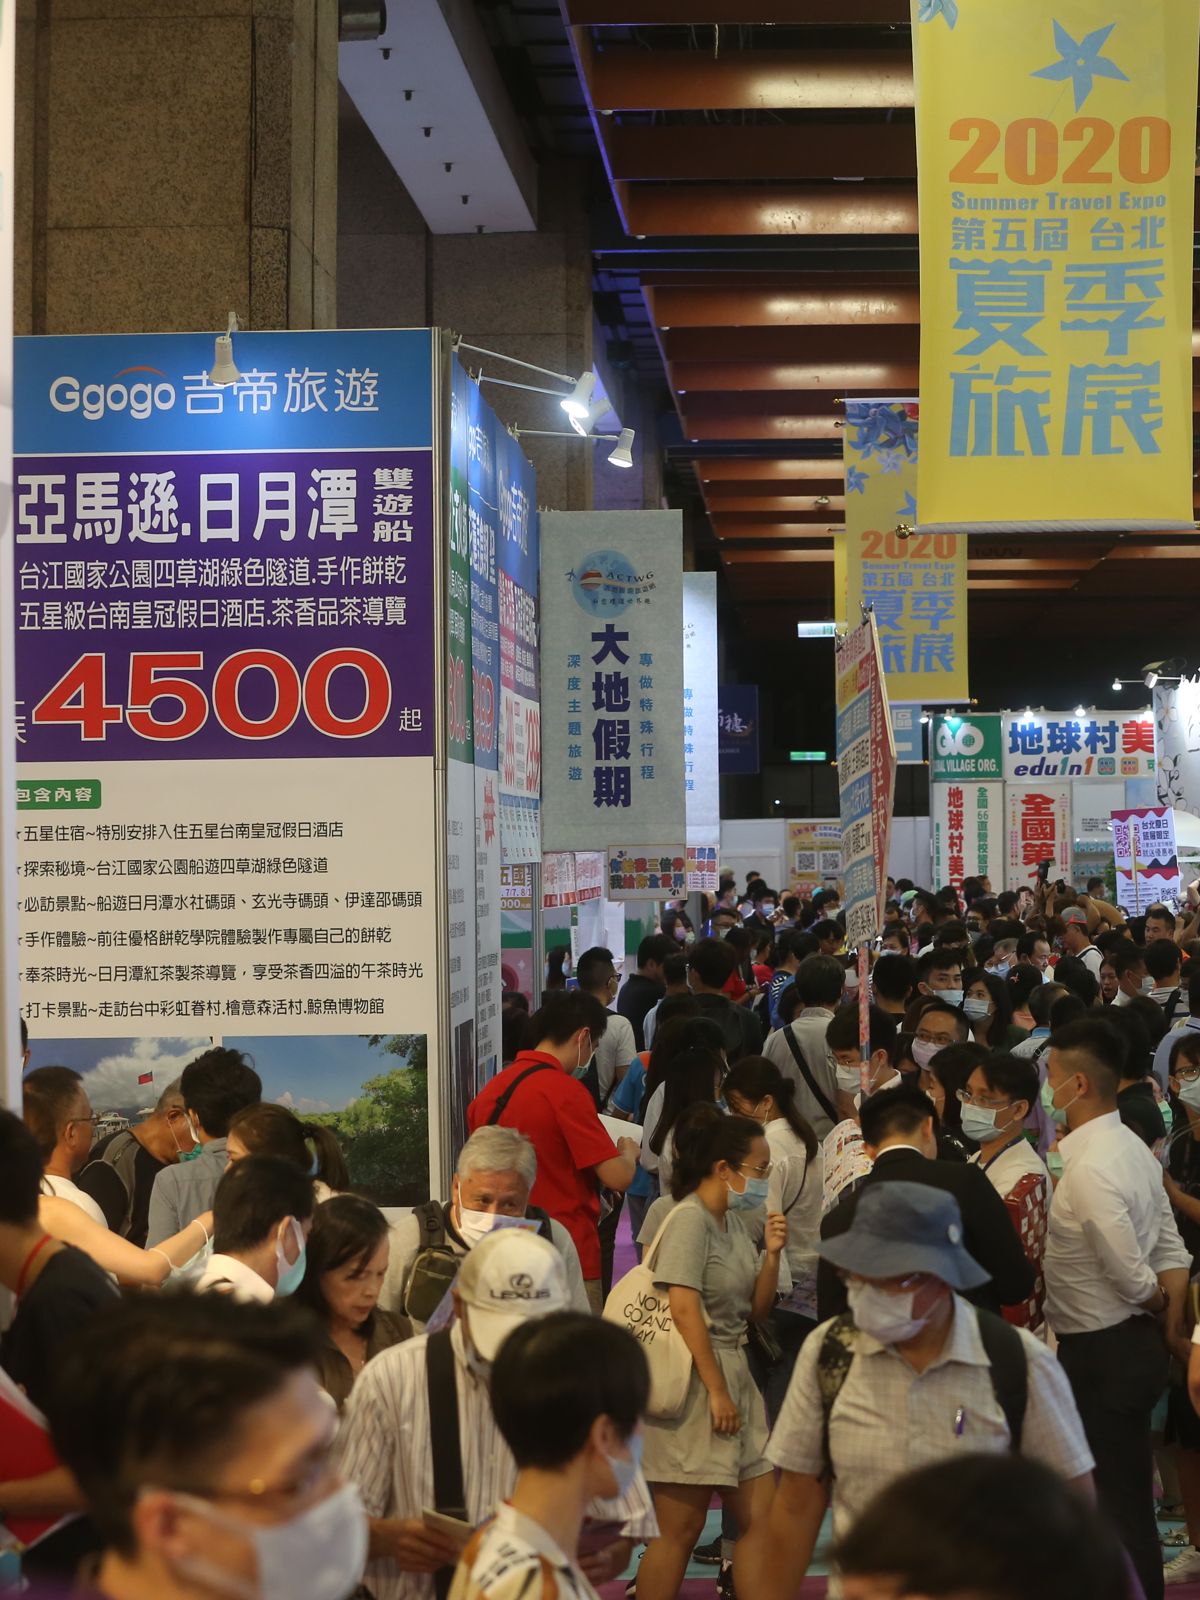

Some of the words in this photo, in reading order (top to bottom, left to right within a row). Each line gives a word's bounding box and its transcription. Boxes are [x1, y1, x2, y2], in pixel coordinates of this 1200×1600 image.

[949, 117, 1172, 185] 2020
[951, 191, 1039, 211] Summer
[1045, 192, 1112, 210] Travel
[1119, 192, 1167, 210] Expo
[1090, 215, 1166, 251] 台北
[949, 257, 1166, 357] 夏季
[49, 375, 176, 420] Ggogo
[949, 360, 1164, 457] 旅展
[373, 467, 414, 543] 雙遊船
[31, 646, 393, 742] 4500
[398, 707, 423, 733] 起
[566, 653, 583, 782] 深度主題旅遊
[591, 623, 632, 808] 大地假期
[638, 652, 655, 780] 專做特殊行程
[623, 1303, 644, 1323] GO
[635, 1291, 671, 1313] NOW
